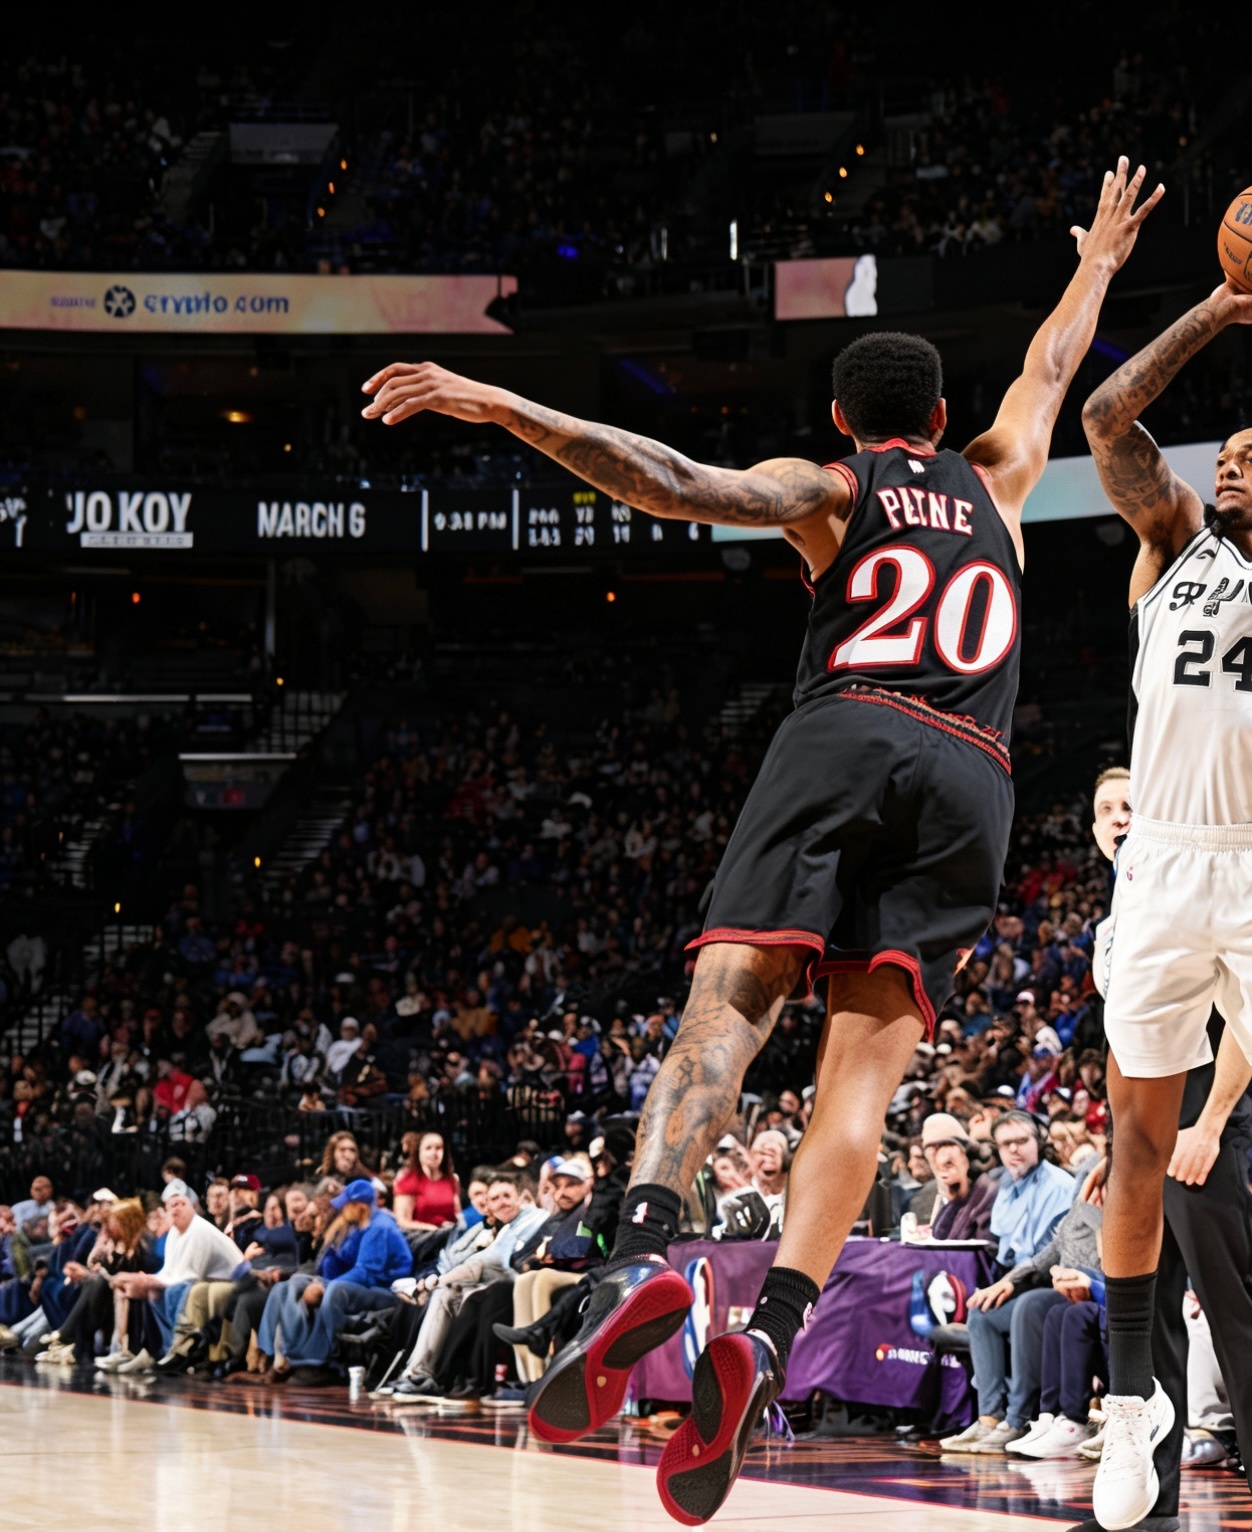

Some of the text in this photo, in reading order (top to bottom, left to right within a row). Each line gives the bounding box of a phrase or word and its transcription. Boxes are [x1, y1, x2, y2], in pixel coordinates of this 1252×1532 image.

[119, 491, 192, 533] KOY
[257, 501, 366, 539] MARCH 6
[827, 543, 1018, 675] 20
